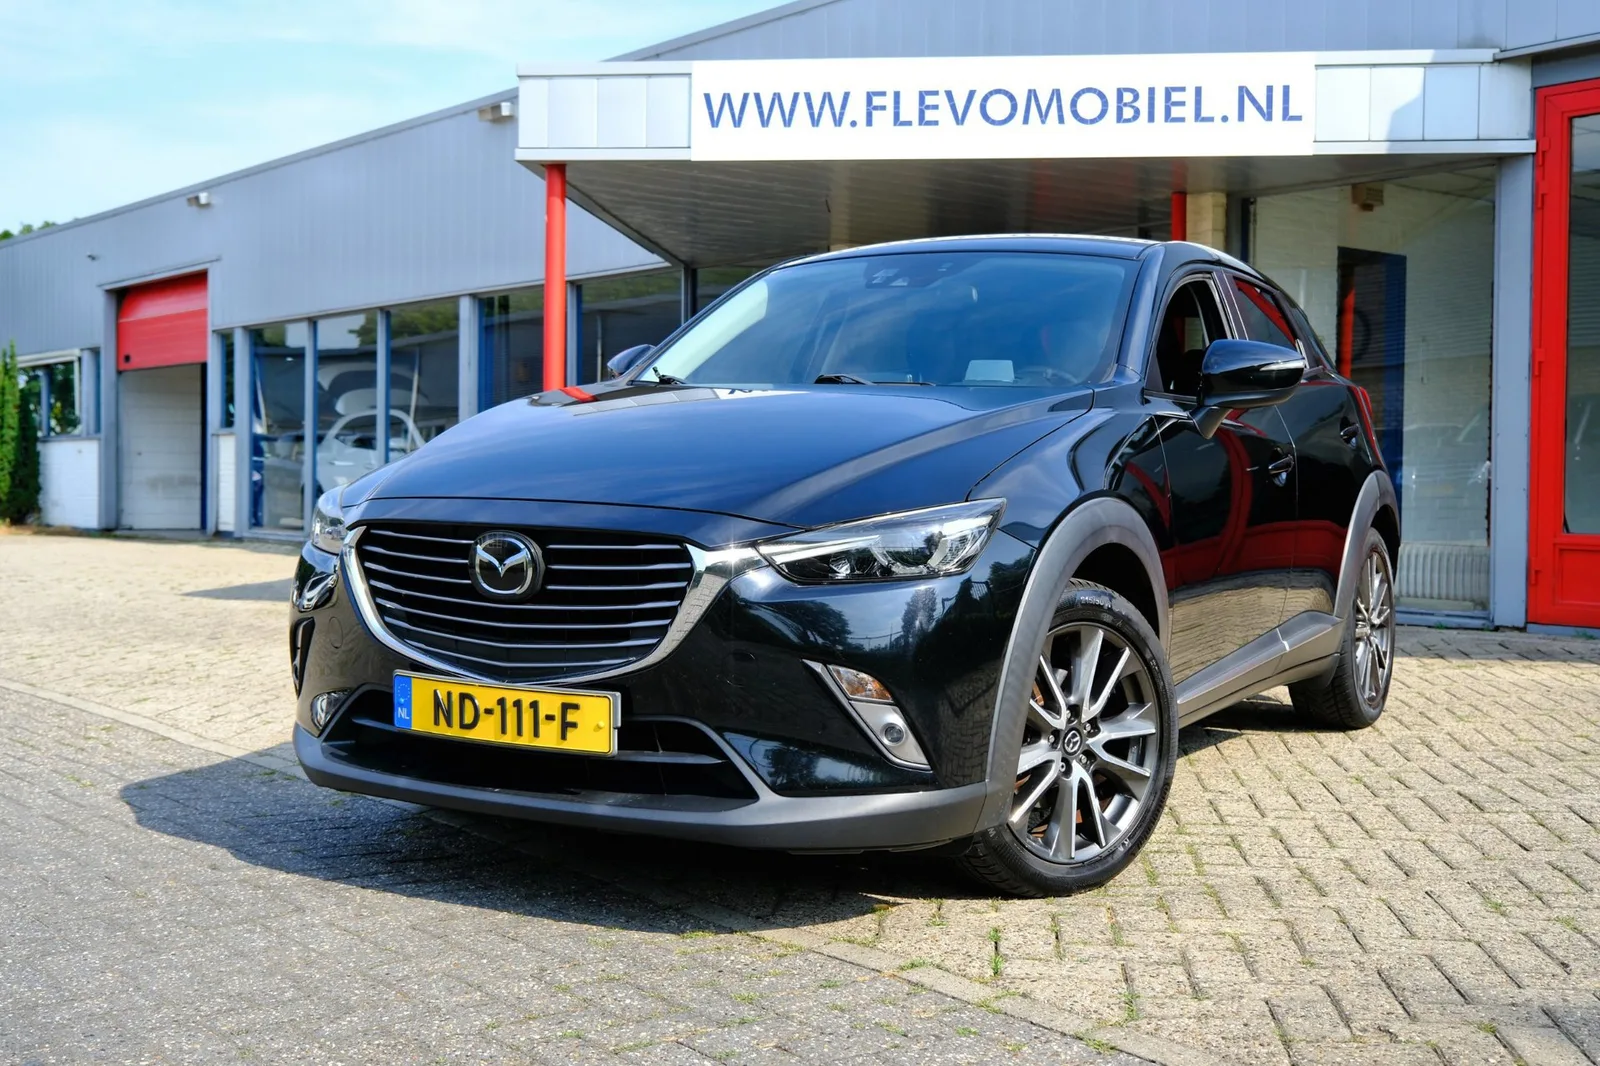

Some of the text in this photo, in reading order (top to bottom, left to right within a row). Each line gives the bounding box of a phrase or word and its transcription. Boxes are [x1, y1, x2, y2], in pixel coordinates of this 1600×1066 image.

[703, 84, 1303, 129] WWW.FLEVOMOBIEL.NL
[397, 706, 410, 720] NL
[433, 688, 581, 741] ND-111-F
